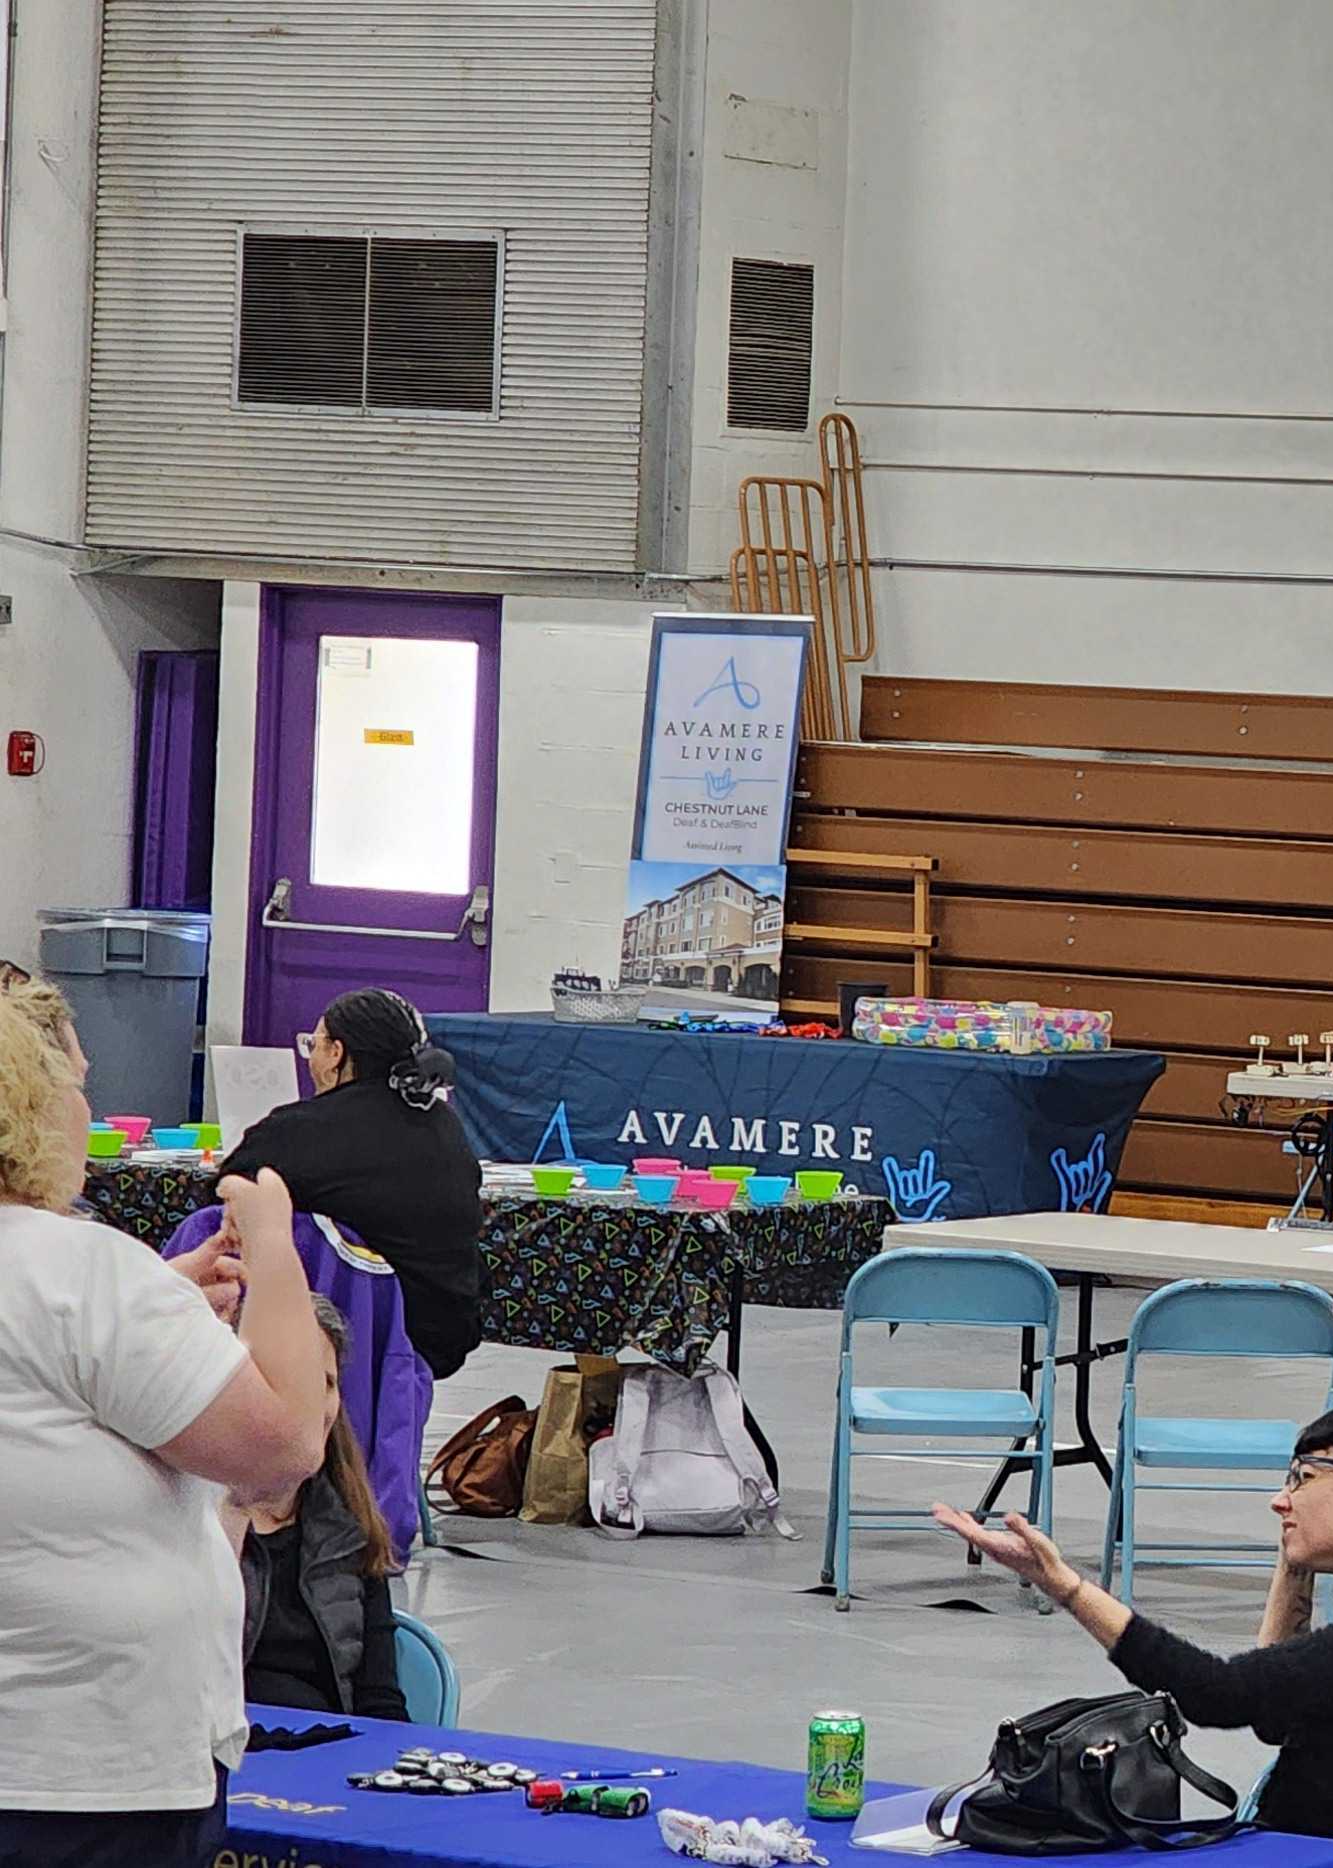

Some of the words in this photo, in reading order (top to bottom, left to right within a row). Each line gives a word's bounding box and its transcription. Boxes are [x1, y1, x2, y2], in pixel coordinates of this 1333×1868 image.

[664, 720, 786, 740] AVAMERE
[681, 745, 764, 762] LIVING
[664, 802, 735, 816] CHESTNUT
[736, 804, 769, 816] LANE
[617, 1109, 873, 1161] AVAMERE
